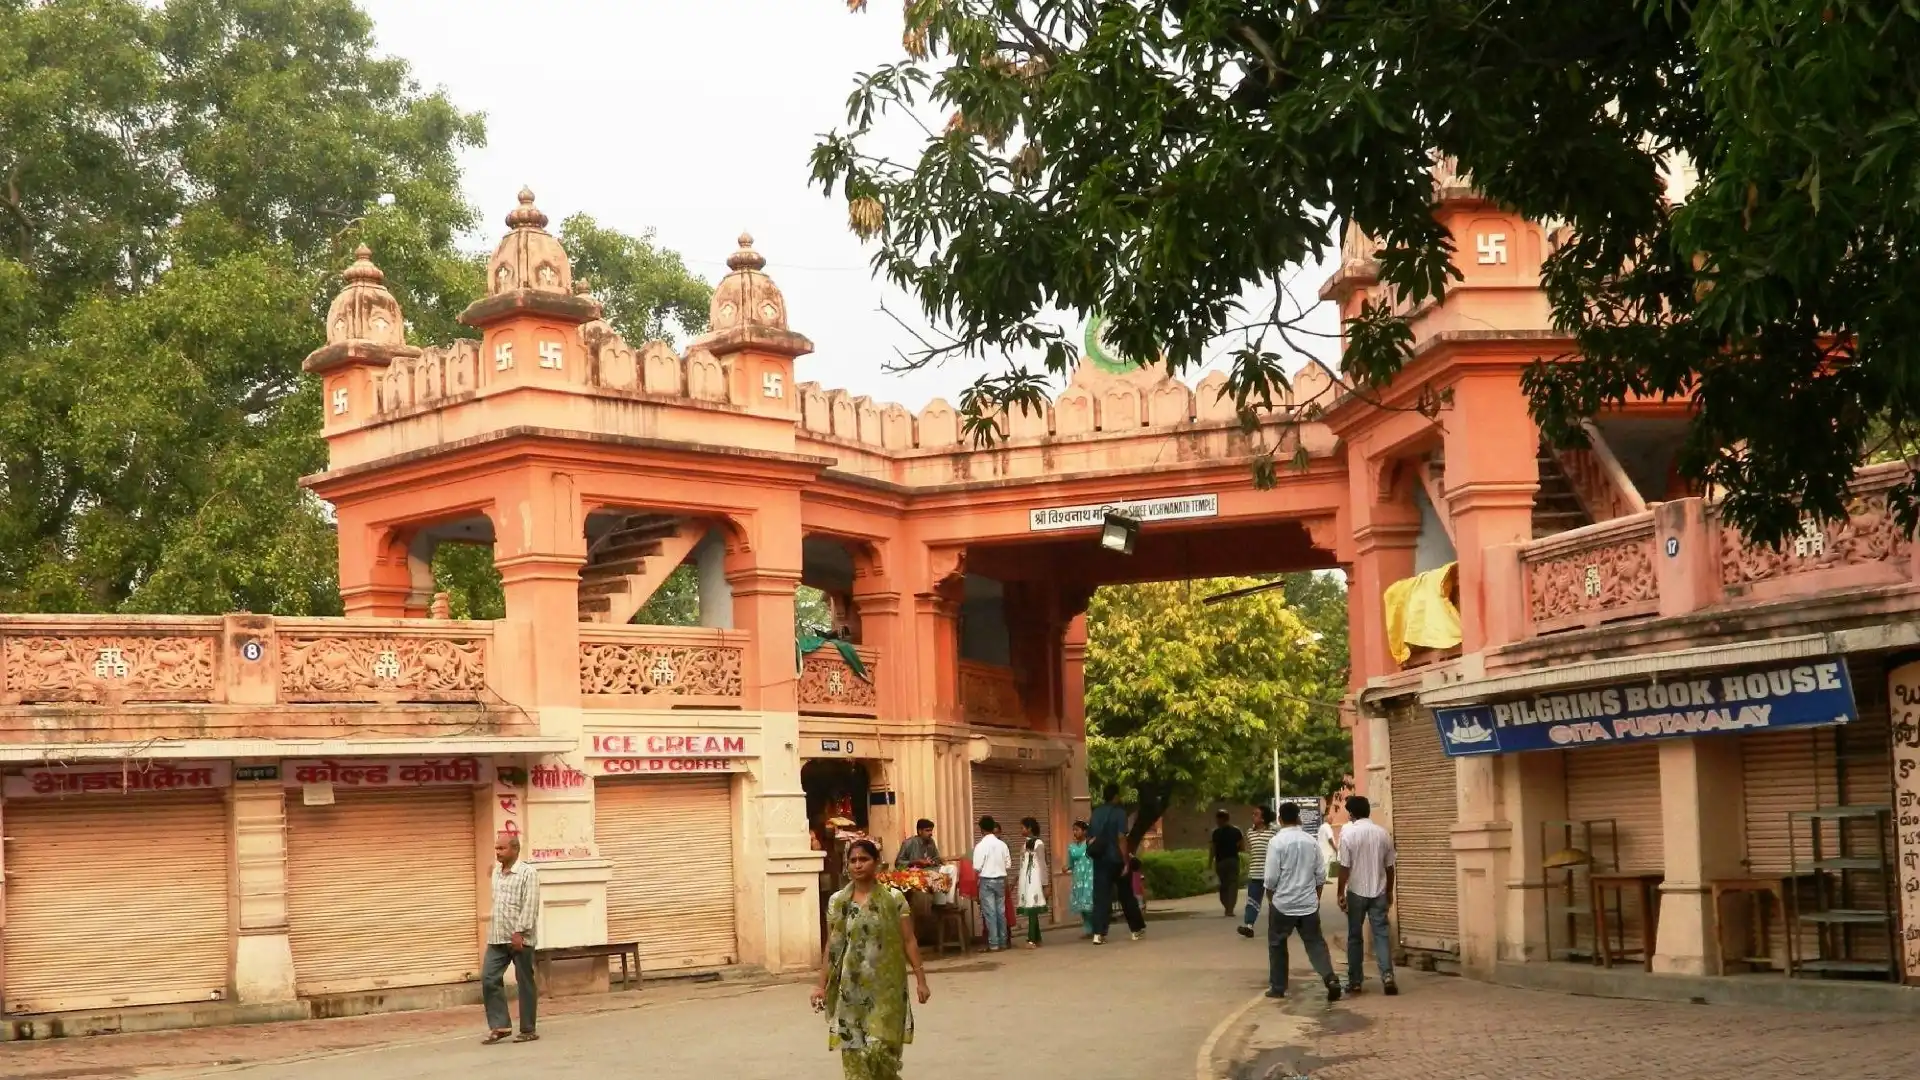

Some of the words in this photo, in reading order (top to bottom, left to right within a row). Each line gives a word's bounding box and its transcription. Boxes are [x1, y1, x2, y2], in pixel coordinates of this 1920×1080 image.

[1035, 510, 1046, 525] श्री
[1048, 508, 1091, 525] विश्वनाथ
[1128, 503, 1147, 518] SHREE
[1148, 500, 1191, 516] VISHWANATH
[1191, 497, 1216, 513] TEMPLE
[1667, 539, 1677, 555] 17
[247, 644, 258, 659] 8
[1494, 688, 1622, 728] PILGRIMS
[1624, 679, 1715, 712] BOOK
[1721, 662, 1842, 702] HOUSE
[1612, 703, 1772, 739] PUSTAKALAY
[592, 735, 637, 753] ICE
[646, 735, 745, 753] CREAM
[295, 759, 390, 785] कोल्ड
[603, 759, 664, 773] COLD
[668, 758, 732, 772] COFFEE
